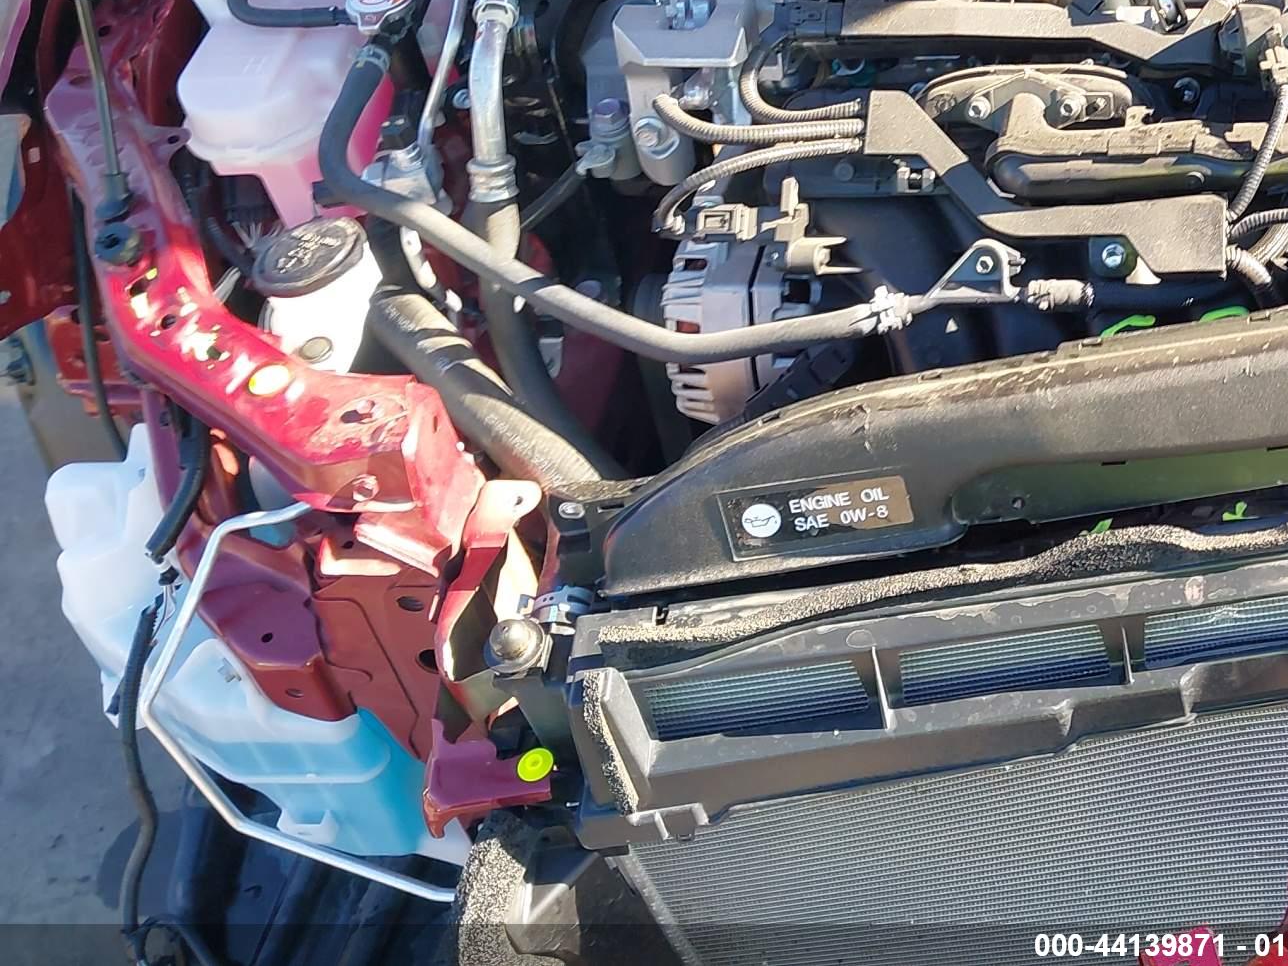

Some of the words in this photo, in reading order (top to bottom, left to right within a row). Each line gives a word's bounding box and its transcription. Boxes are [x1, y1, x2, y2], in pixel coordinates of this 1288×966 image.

[789, 491, 851, 513] ENGINE
[860, 487, 889, 503] OIL
[794, 513, 829, 531] SAE
